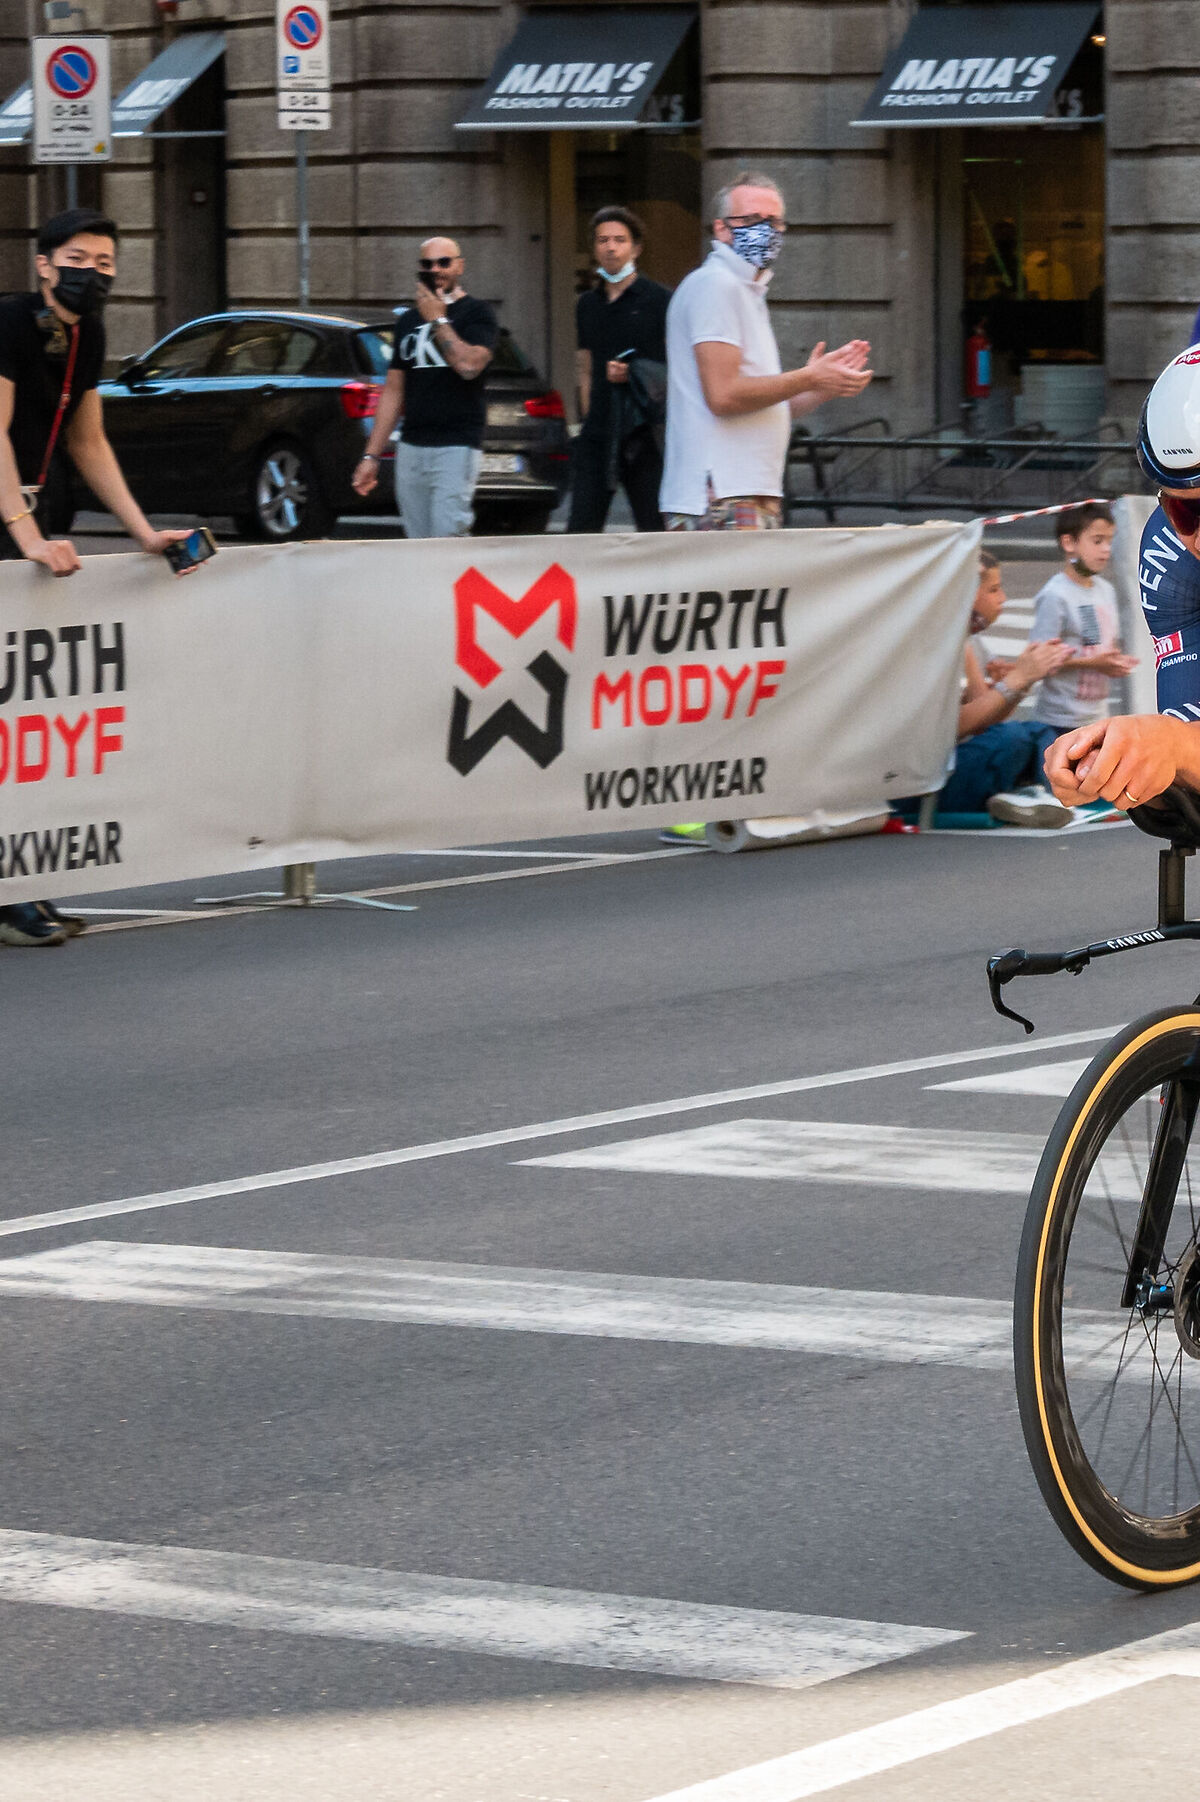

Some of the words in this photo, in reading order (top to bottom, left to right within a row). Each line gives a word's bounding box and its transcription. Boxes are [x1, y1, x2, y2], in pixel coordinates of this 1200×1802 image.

[495, 61, 654, 94] MATIA'S
[890, 55, 1057, 91] MATIA'S
[485, 97, 564, 110] FASHION
[564, 96, 635, 109] OUTLET
[880, 93, 963, 107] FASHION
[965, 90, 1040, 105] OUTLET
[1162, 447, 1194, 456] CANYON
[1160, 652, 1198, 669] SHAMPOO
[591, 660, 787, 730] MODYF
[584, 757, 767, 811] WORKWEAR
[1107, 929, 1165, 950] CANYON
